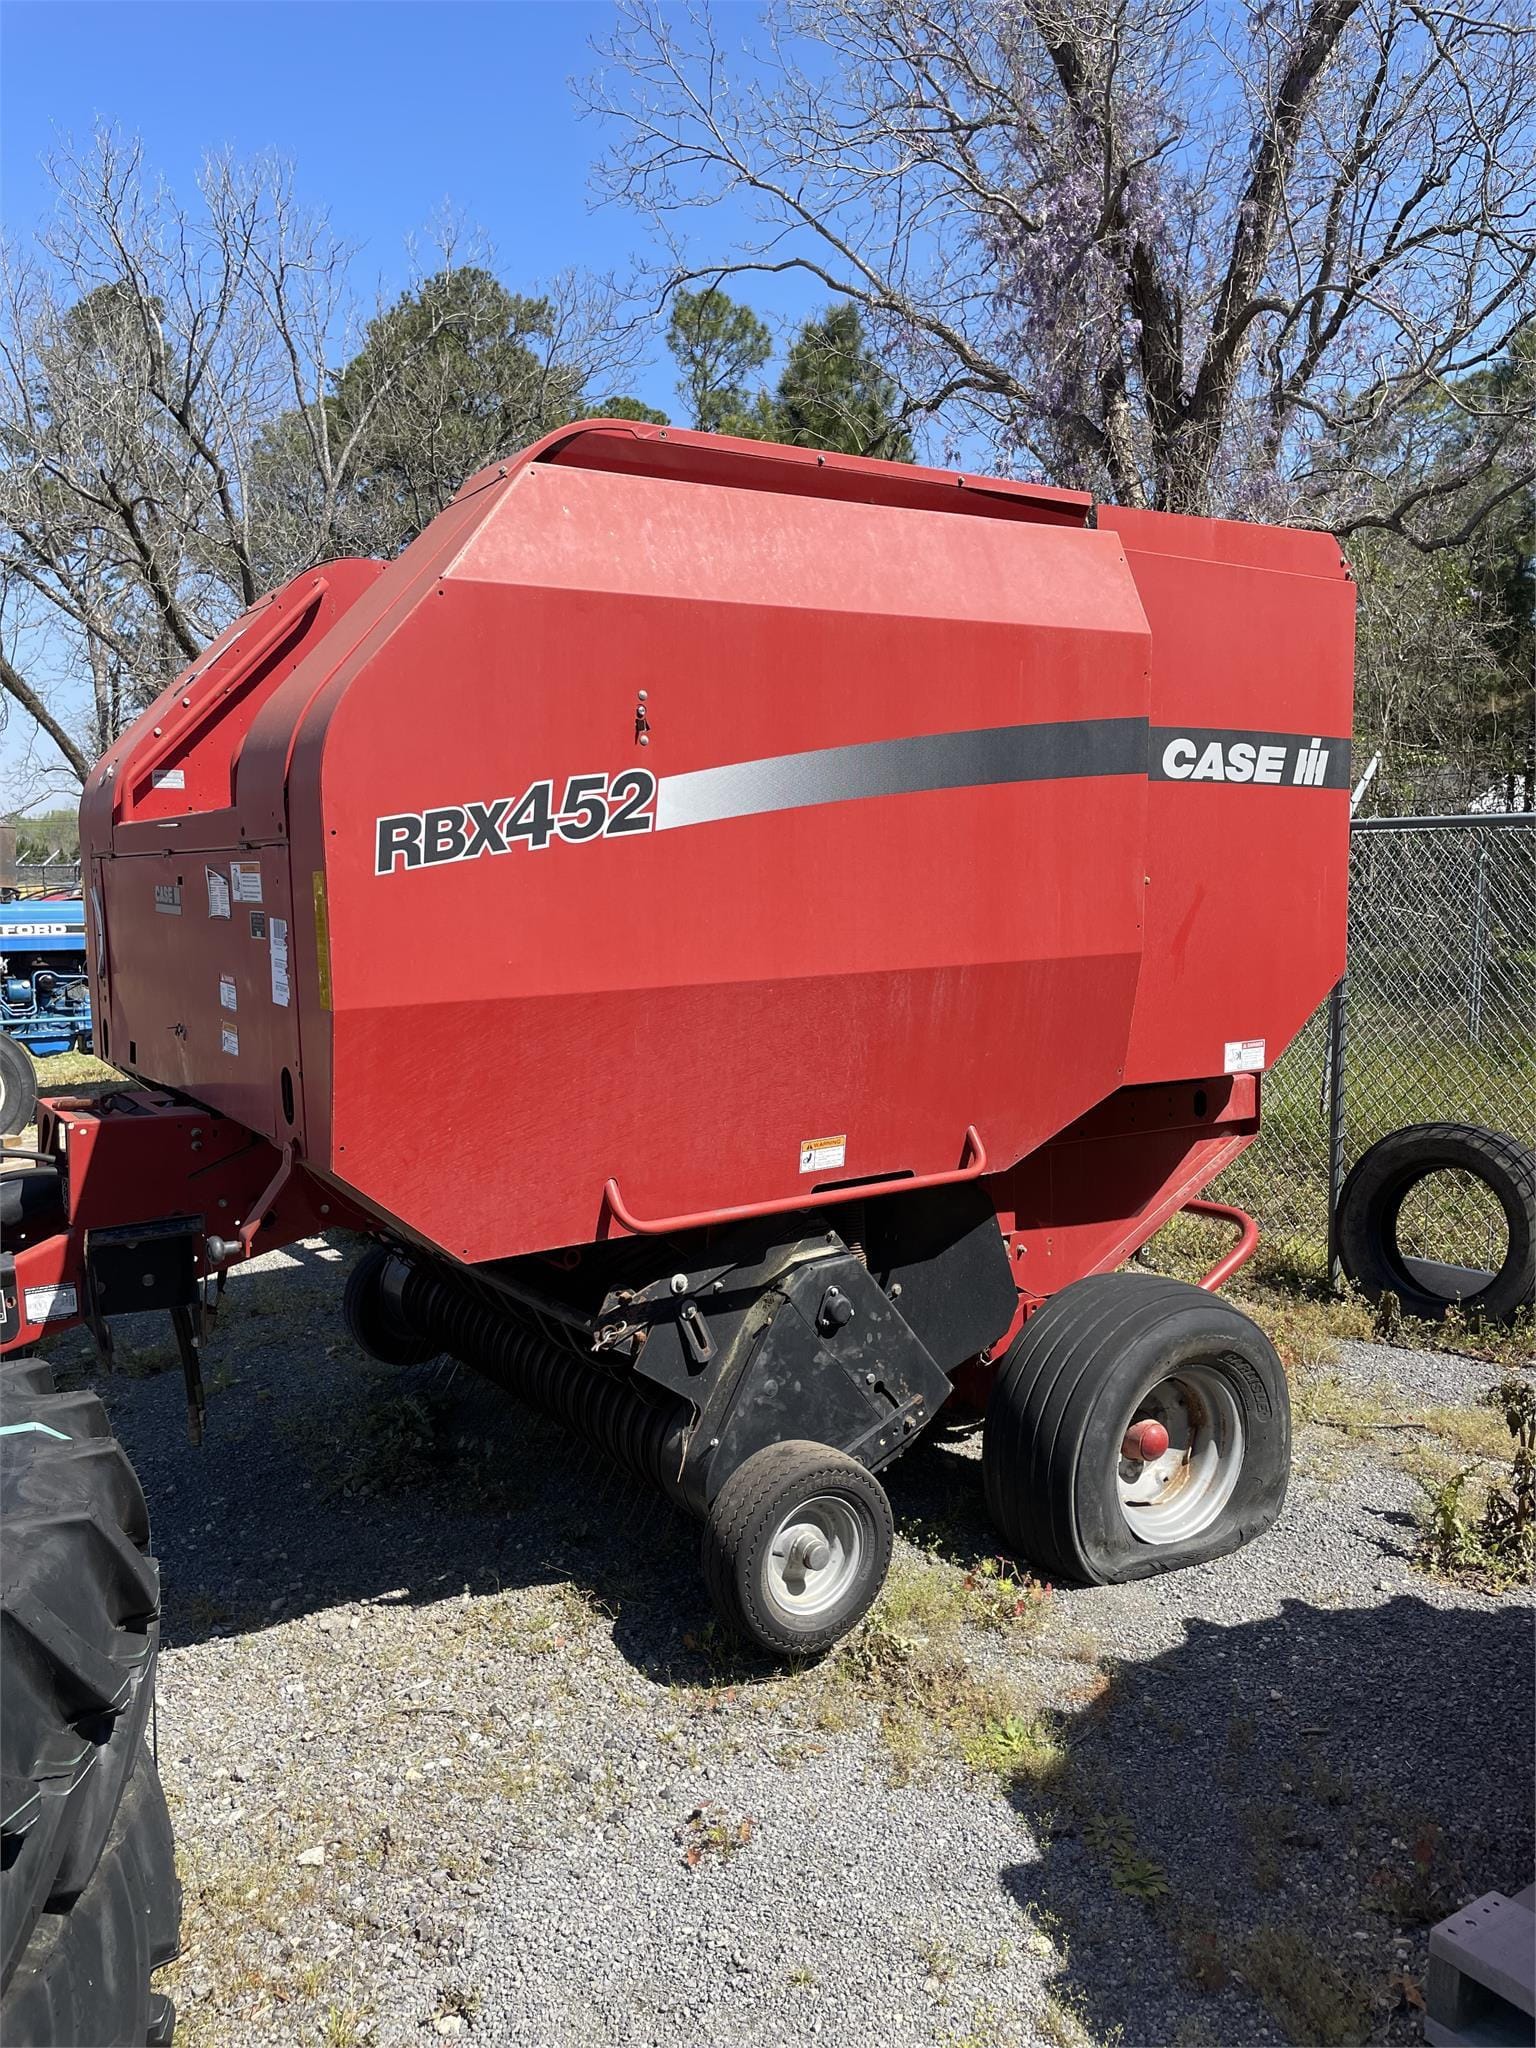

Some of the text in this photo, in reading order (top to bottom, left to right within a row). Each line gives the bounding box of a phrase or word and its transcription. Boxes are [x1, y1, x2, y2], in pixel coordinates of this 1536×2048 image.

[1162, 738, 1288, 784] CASE
[375, 768, 657, 876] RBX452
[154, 885, 173, 904] CASE
[2, 925, 67, 935] FORD
[813, 1138, 842, 1148] WARNING
[1223, 1353, 1270, 1414] CARLISLE
